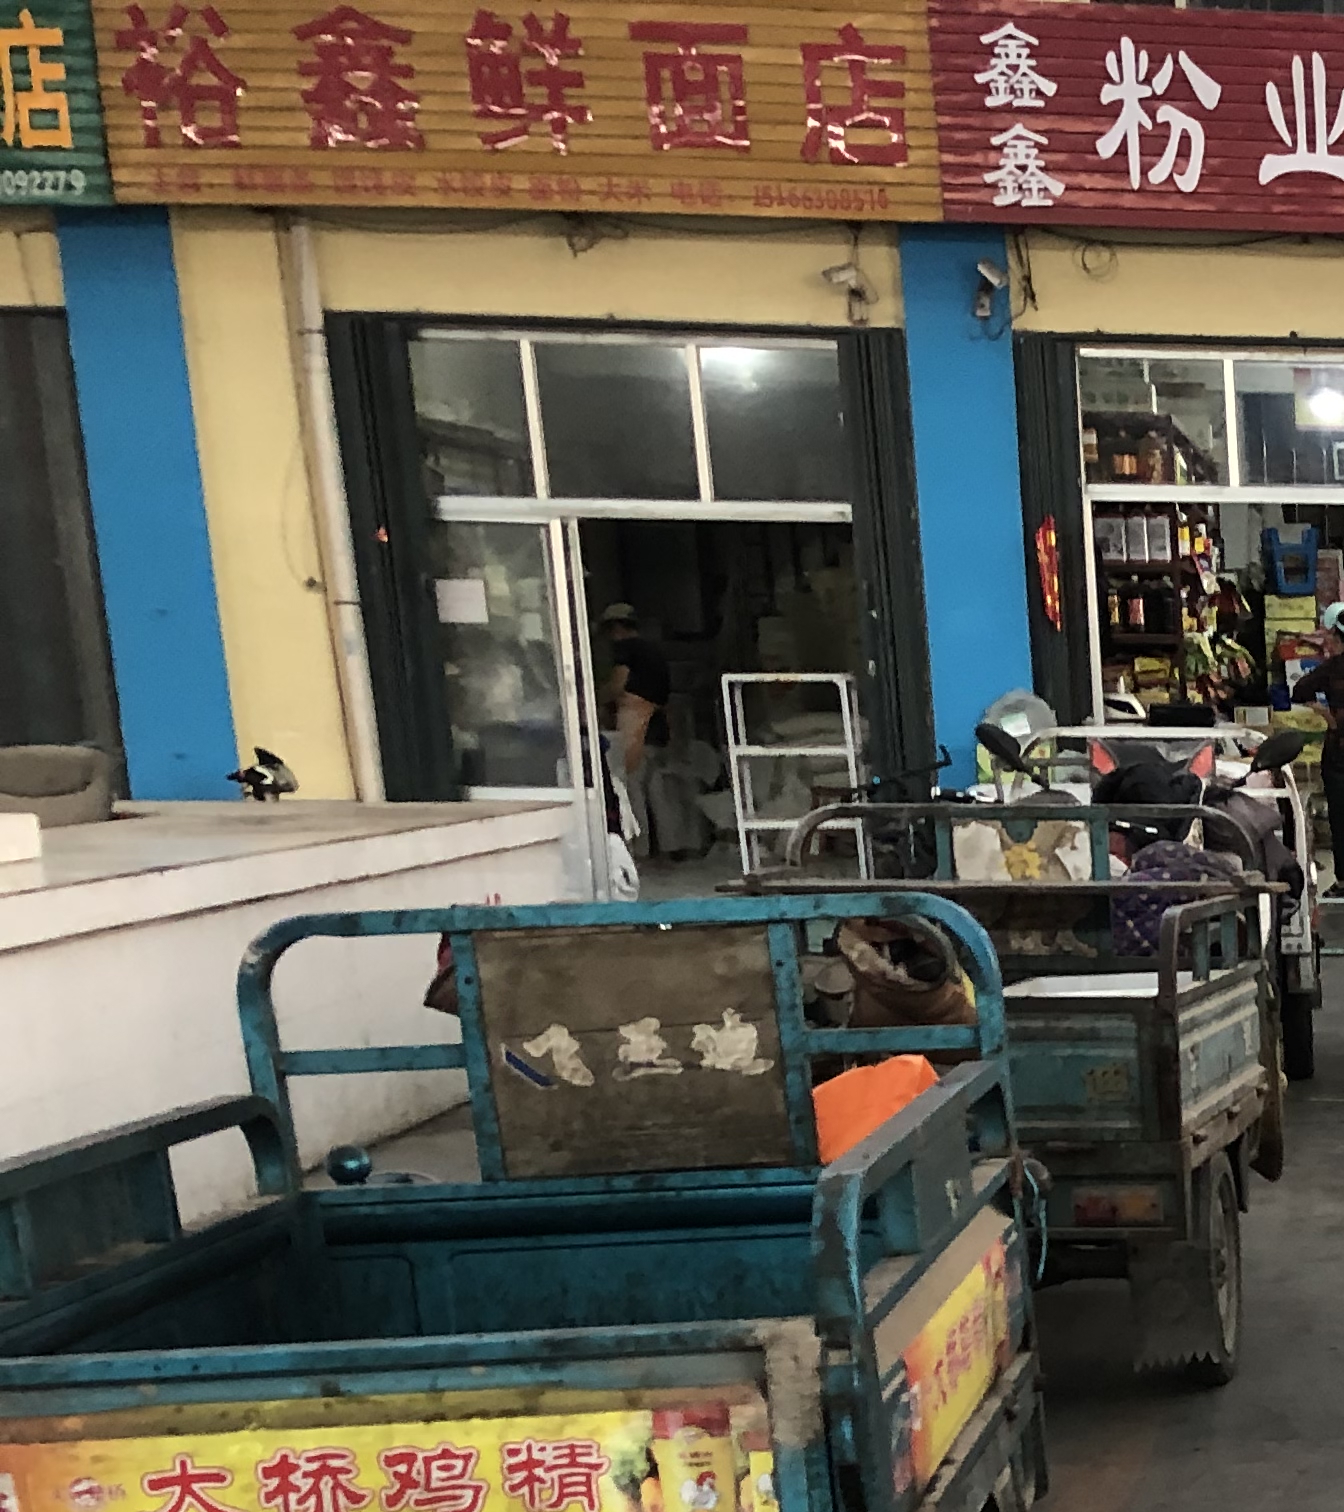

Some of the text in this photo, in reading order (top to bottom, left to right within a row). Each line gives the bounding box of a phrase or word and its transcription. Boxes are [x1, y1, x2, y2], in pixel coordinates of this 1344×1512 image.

[0, 8, 73, 148] 店
[115, 3, 907, 167] 裕鑫鲜面店
[974, 22, 1066, 206] 鑫鑫
